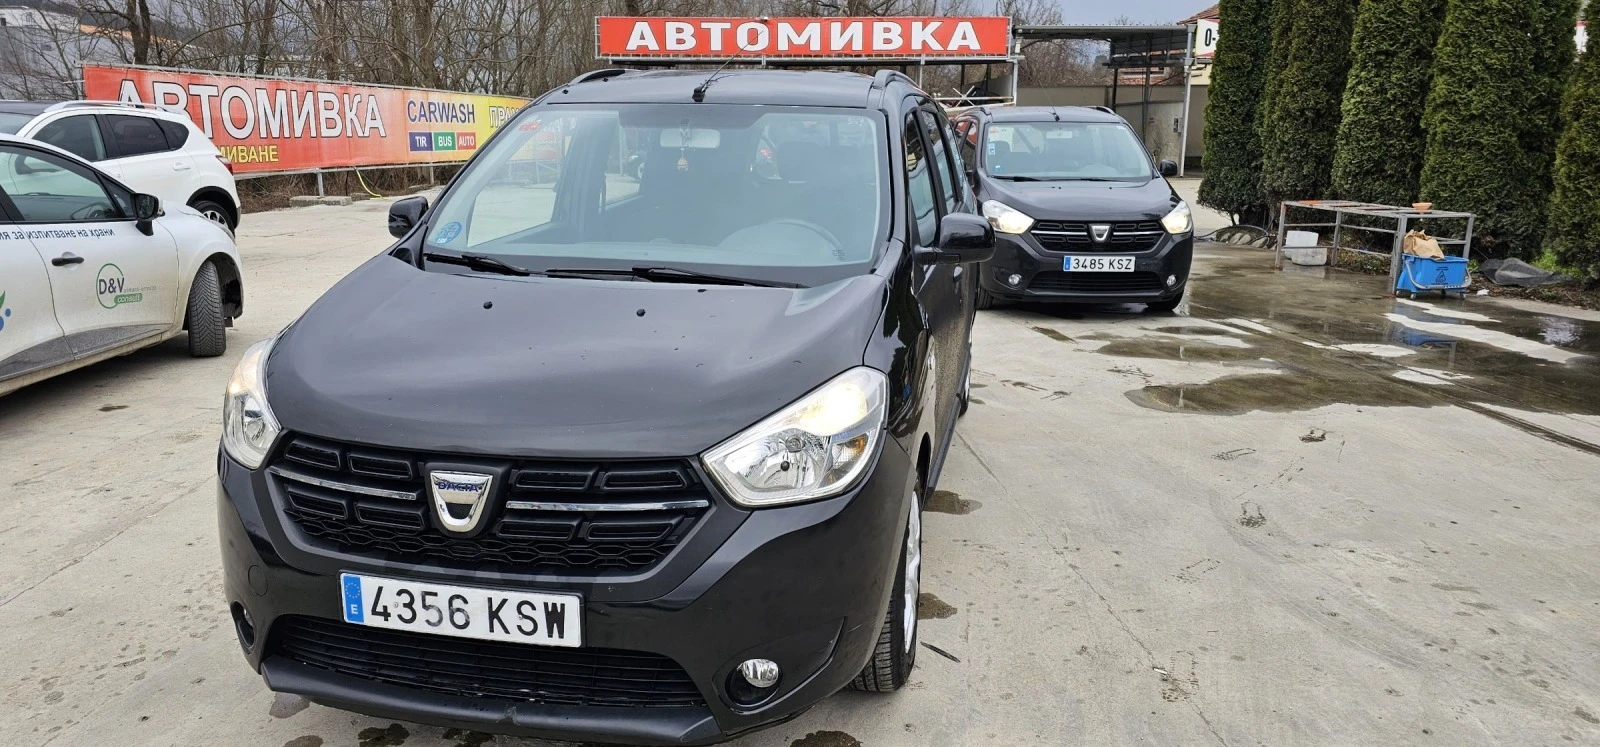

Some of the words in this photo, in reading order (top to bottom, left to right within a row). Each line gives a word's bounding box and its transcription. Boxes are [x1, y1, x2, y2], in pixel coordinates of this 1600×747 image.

[625, 21, 981, 51] АВТОМИВКА
[407, 100, 476, 123] CARWASH
[415, 136, 427, 147] TIR
[438, 135, 453, 147] BUS
[458, 135, 475, 146] AUTO
[12, 231, 25, 240] за
[26, 230, 76, 239] изпитване
[76, 229, 88, 238] на
[88, 228, 115, 239] храни
[1073, 258, 1104, 270] 3485
[1108, 258, 1132, 270] KSZ
[99, 277, 125, 295] D&V
[437, 482, 479, 492] DACIA
[350, 604, 359, 615] E
[370, 585, 471, 630] 4356
[487, 596, 566, 639] KSW
